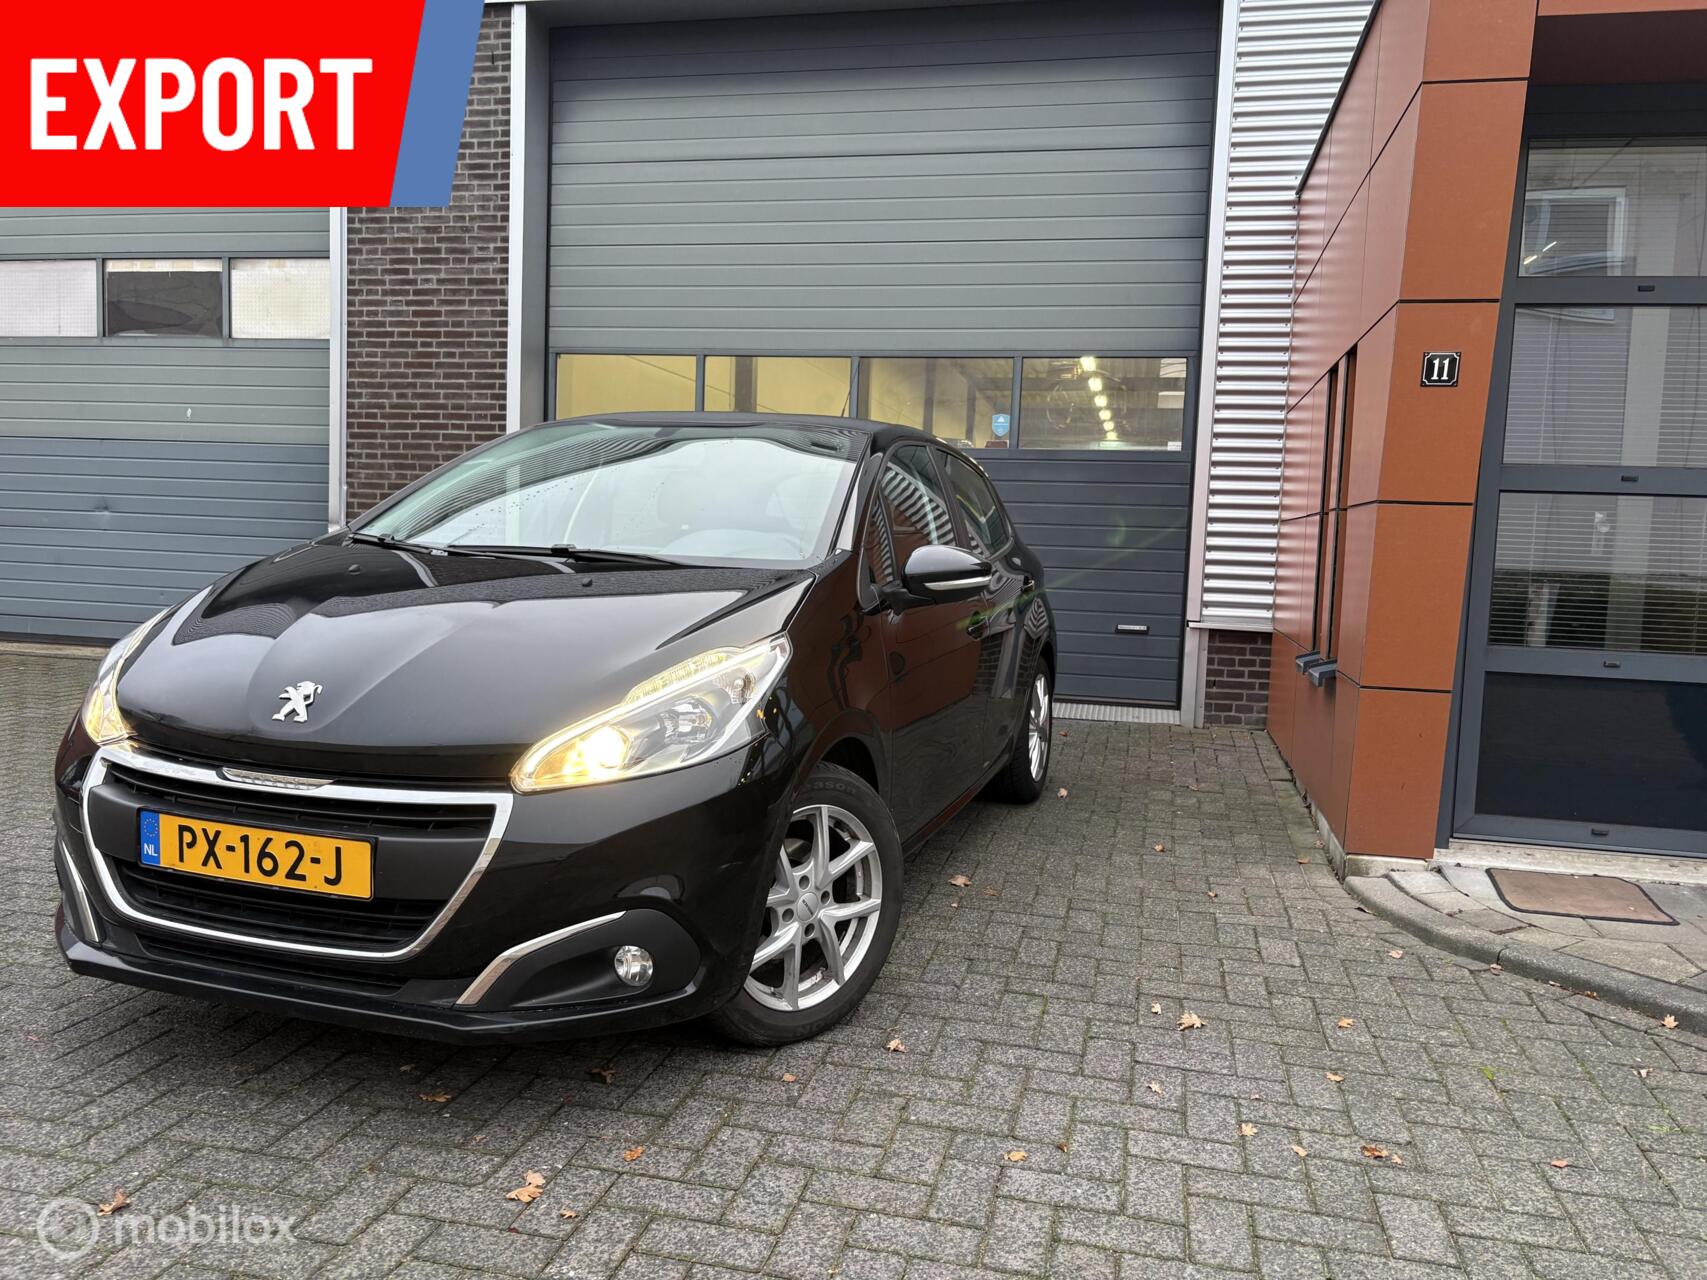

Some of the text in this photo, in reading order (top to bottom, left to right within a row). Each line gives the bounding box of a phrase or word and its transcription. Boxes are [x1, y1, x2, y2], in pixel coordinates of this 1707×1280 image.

[1430, 357, 1450, 380] 11
[144, 843, 158, 857] NL
[177, 824, 342, 886] PX-162-J
